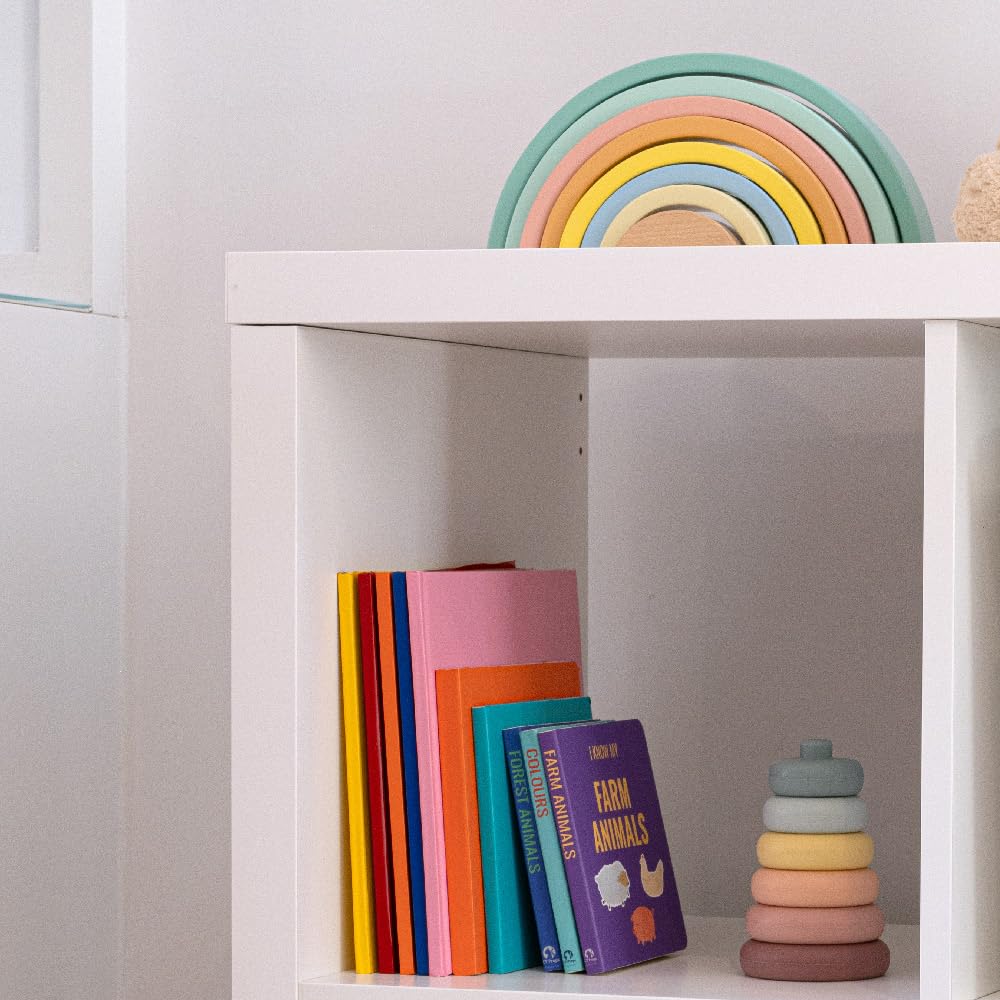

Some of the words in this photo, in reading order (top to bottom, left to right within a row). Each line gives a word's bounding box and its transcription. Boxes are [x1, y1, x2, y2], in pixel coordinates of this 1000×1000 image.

[509, 751, 529, 804] FOREST
[519, 809, 541, 874] ANIMALS
[526, 748, 548, 818] COLOURS
[544, 749, 562, 791] FARM
[553, 795, 576, 860] ANIMALS
[593, 777, 632, 813] FARM
[592, 812, 649, 854] ANIMALS
